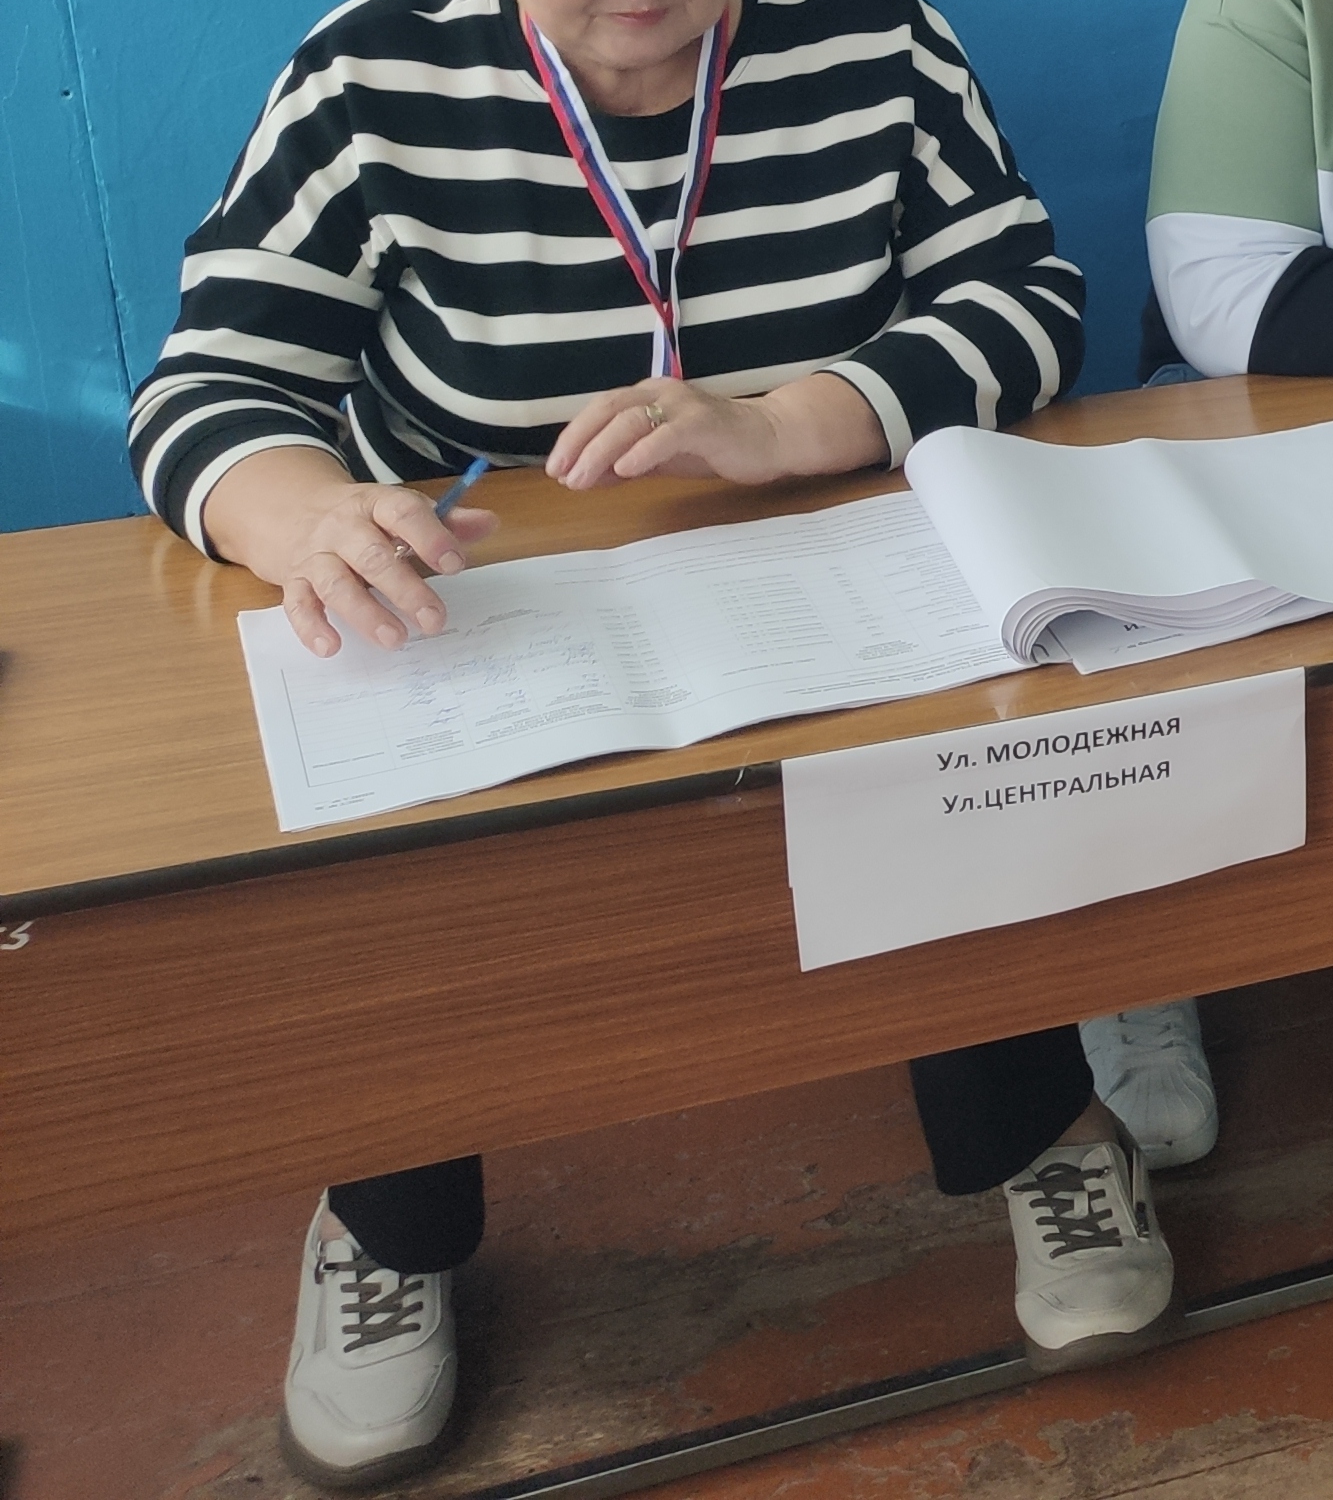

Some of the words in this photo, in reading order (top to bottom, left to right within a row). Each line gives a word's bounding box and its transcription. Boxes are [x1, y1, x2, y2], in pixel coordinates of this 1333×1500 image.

[937, 749, 979, 772] Ул.
[986, 716, 1182, 765] МОЛОДЕЖНАЯ
[942, 760, 1172, 815] Ул.ЦЕНТРАЛЬНАЯ
